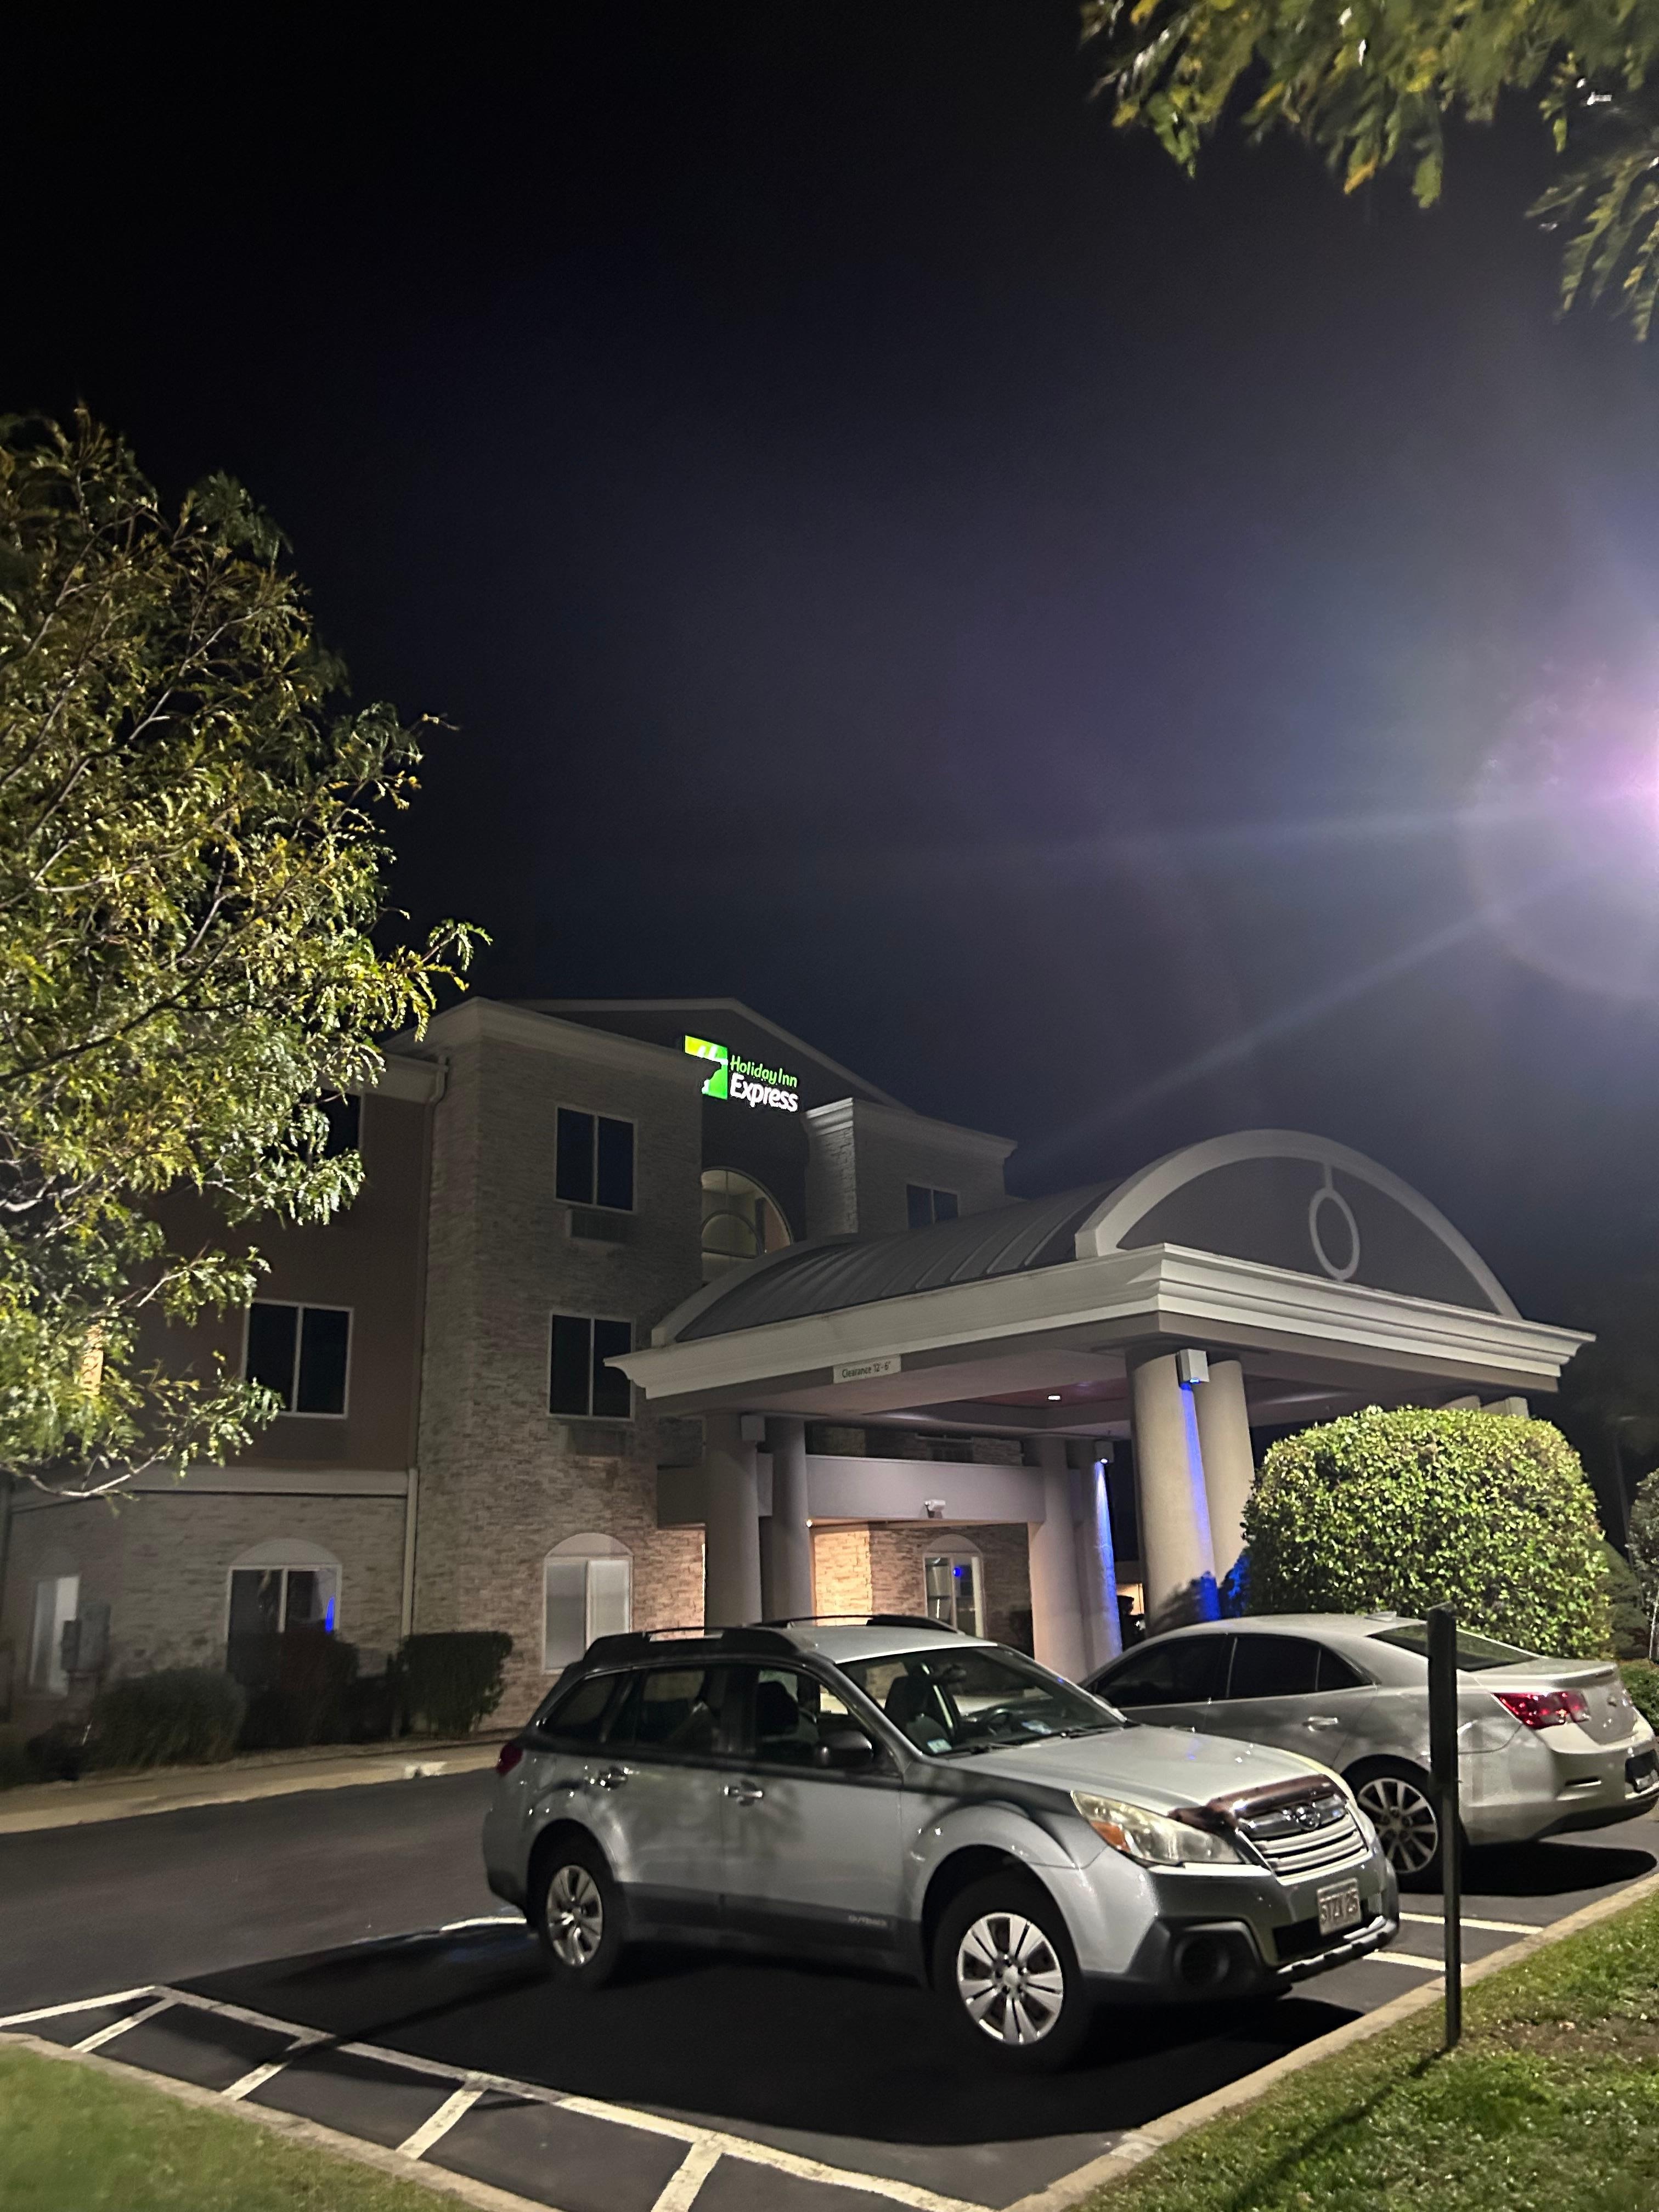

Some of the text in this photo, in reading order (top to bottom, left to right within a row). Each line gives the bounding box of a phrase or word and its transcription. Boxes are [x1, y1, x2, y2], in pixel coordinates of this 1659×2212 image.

[730, 1054, 798, 1087] Holiday Inn
[730, 1073, 799, 1111] Express
[842, 1365, 871, 1378] Clearance
